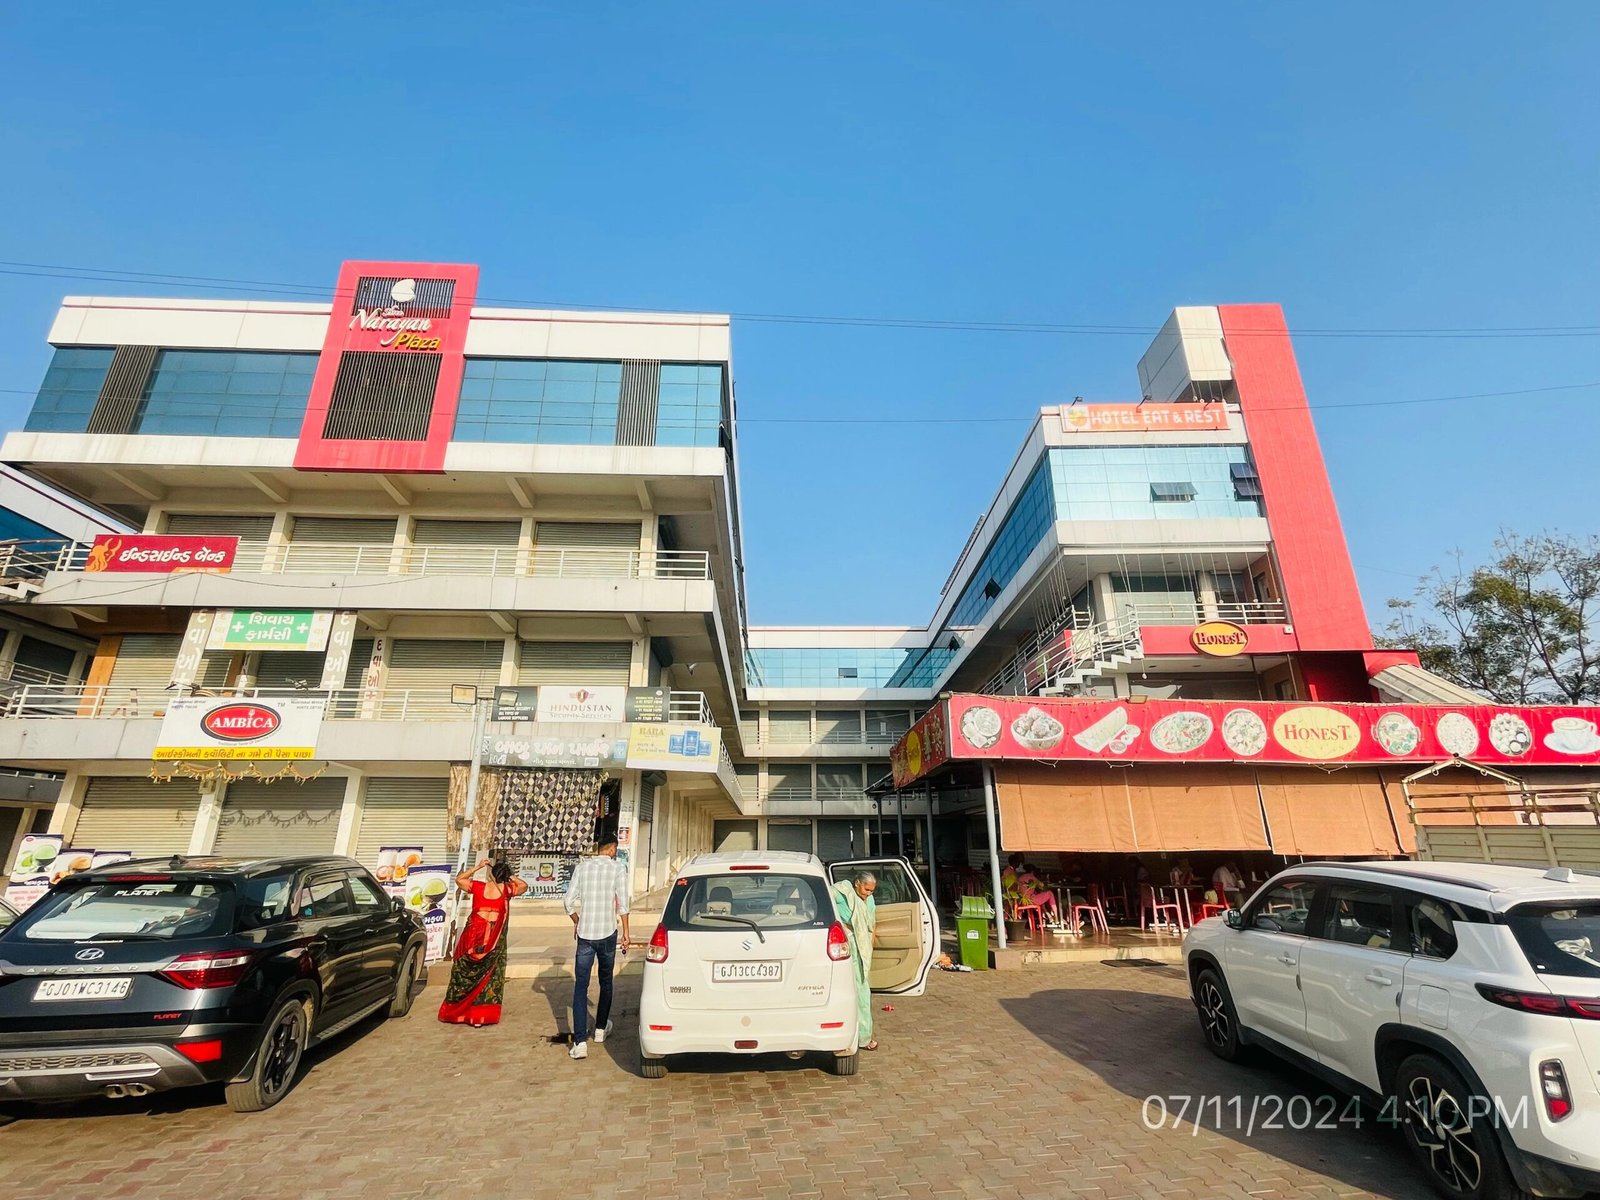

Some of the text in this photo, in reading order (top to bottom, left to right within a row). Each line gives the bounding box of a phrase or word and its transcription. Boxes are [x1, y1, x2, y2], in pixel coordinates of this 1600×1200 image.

[349, 308, 431, 346] Narayan
[395, 333, 440, 349] Plaza
[1089, 408, 1221, 425] HOTEL EAT & REST
[1195, 632, 1245, 645] HONEST
[550, 704, 612, 712] HINDUSTAN
[210, 714, 275, 729] AMBICA
[1283, 724, 1350, 741] HONEST
[114, 888, 163, 897] PLANET
[720, 963, 780, 977] GJ13CC4387
[46, 981, 128, 996] GJ01WC3146
